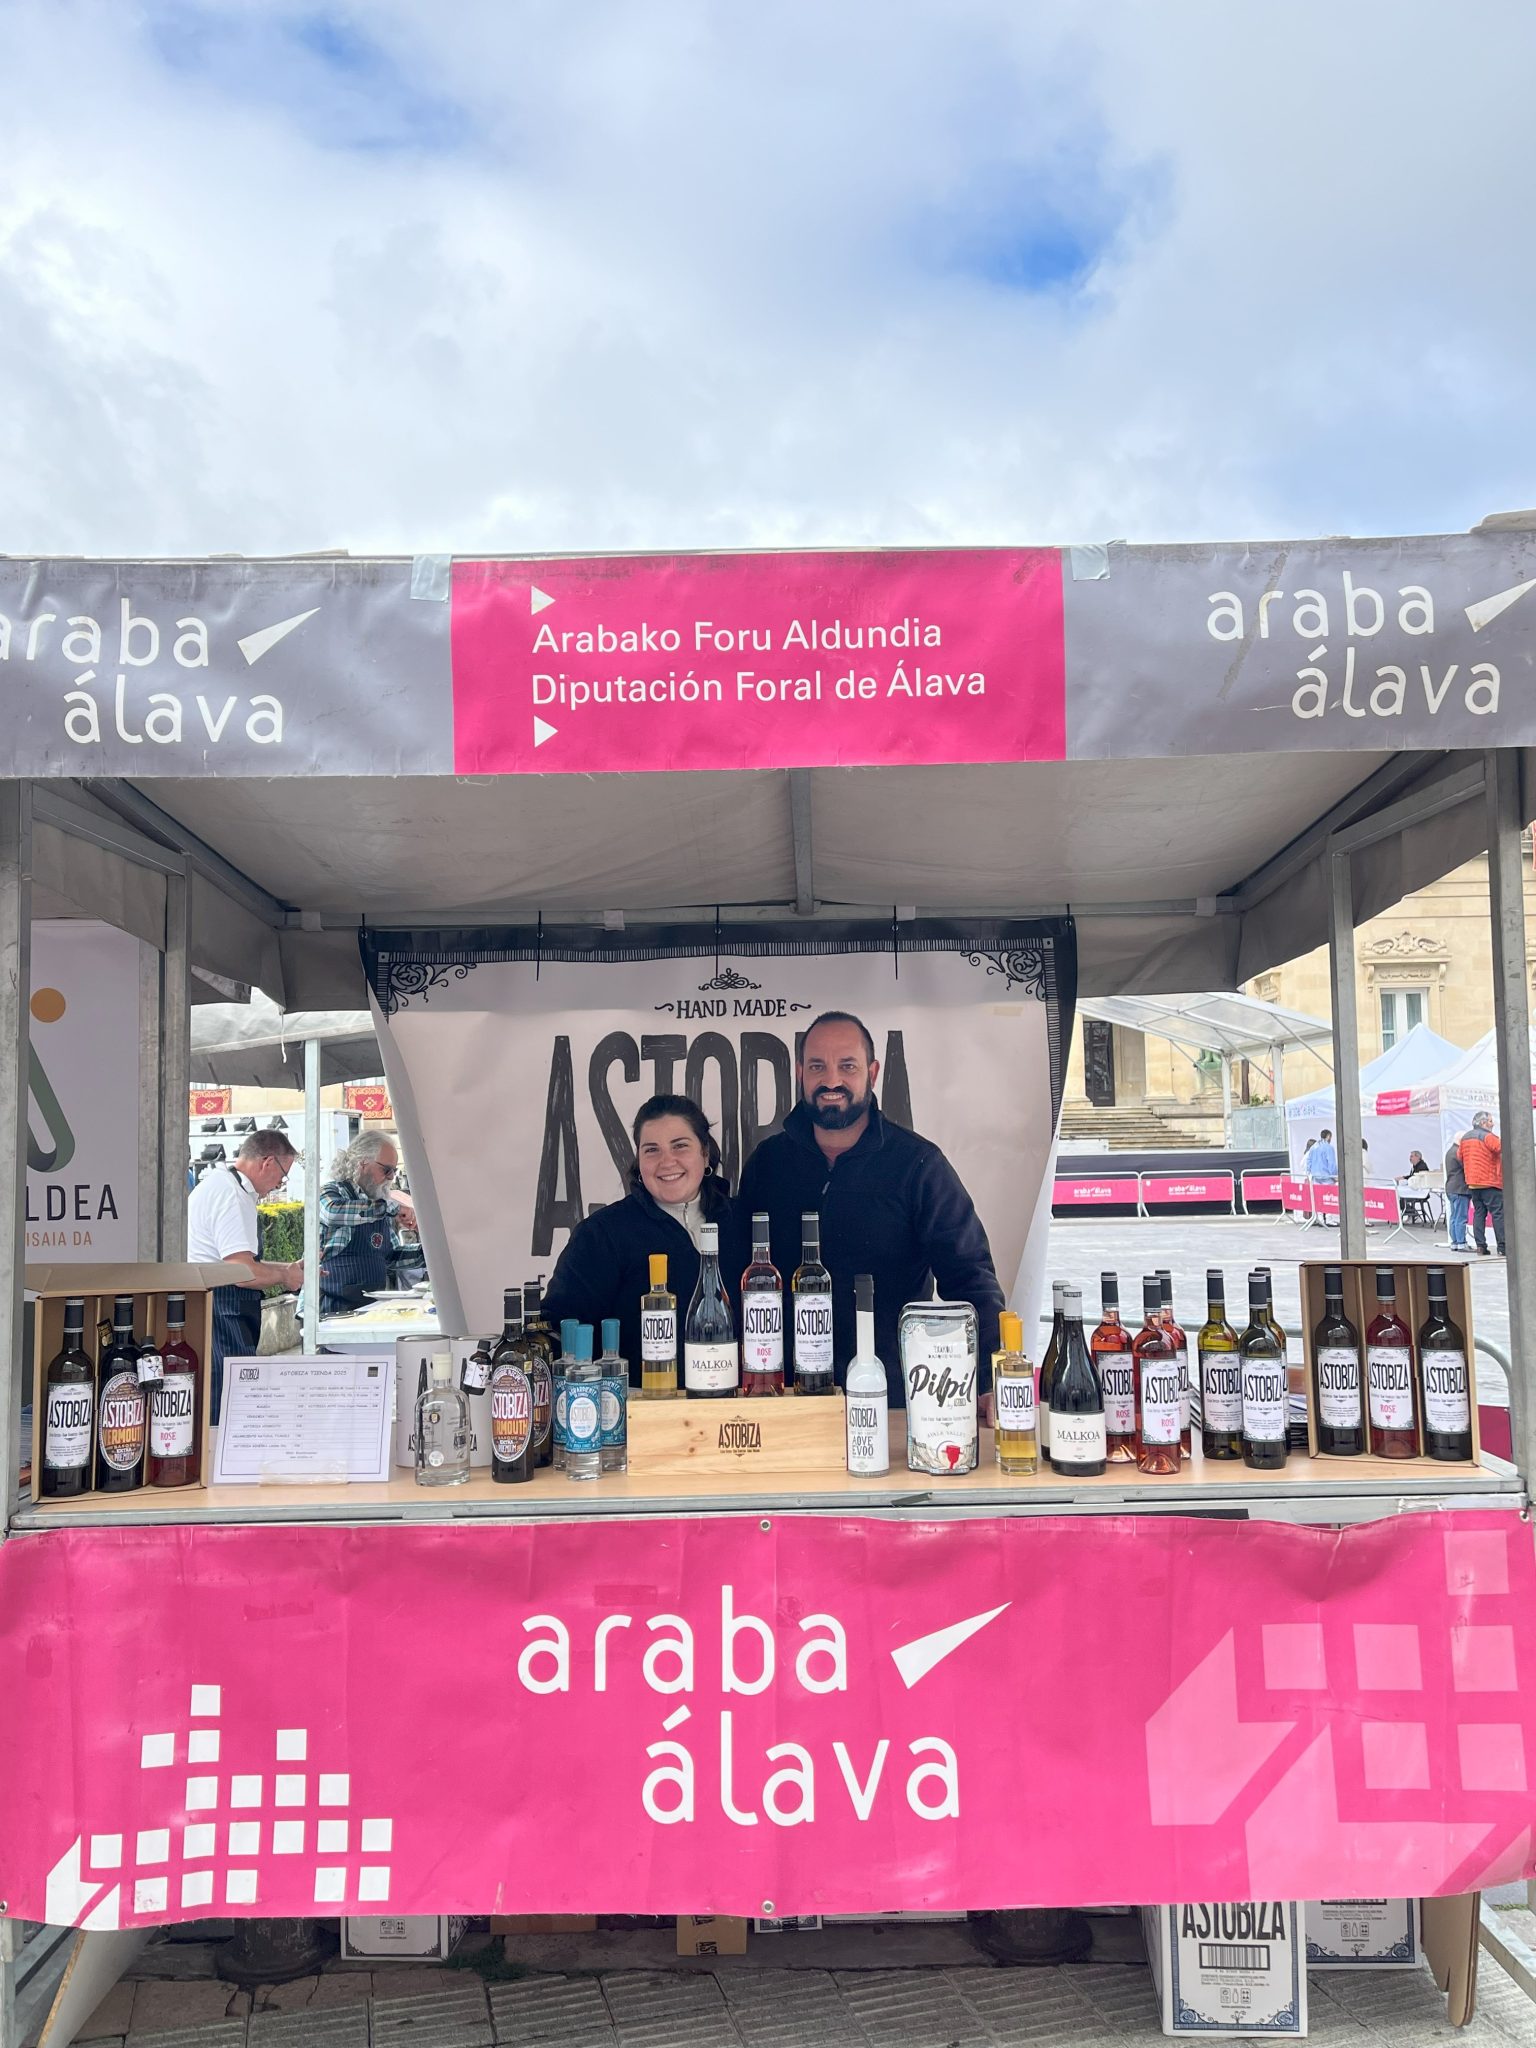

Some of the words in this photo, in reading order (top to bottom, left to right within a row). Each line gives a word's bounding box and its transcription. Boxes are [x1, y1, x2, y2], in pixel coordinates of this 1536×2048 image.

[1207, 571, 1434, 641] araba
[0, 598, 209, 668] raba
[532, 623, 680, 653] Arabako
[694, 621, 771, 651] Foru
[782, 618, 941, 649] Aldundia
[532, 671, 721, 710] Diputación
[737, 670, 821, 701] Foral
[835, 670, 876, 699] de
[887, 661, 986, 697] Álava
[1292, 645, 1500, 719] álava
[63, 670, 283, 744] álava
[676, 999, 727, 1019] HAND
[733, 999, 787, 1017] MADE
[73, 1231, 93, 1246] DA
[643, 1318, 674, 1340] ASTOBIZA
[692, 1360, 733, 1369] MALKOA
[909, 1364, 976, 1408] Pilpil
[718, 1423, 761, 1448] ASTOBIZA
[852, 1436, 873, 1446] AOVE
[852, 1445, 874, 1456] EVOO
[1057, 1430, 1100, 1441] MALKOA
[518, 1584, 848, 1696] araba
[642, 1705, 960, 1827] álava
[1182, 1901, 1286, 1940] ASTOBIZA
